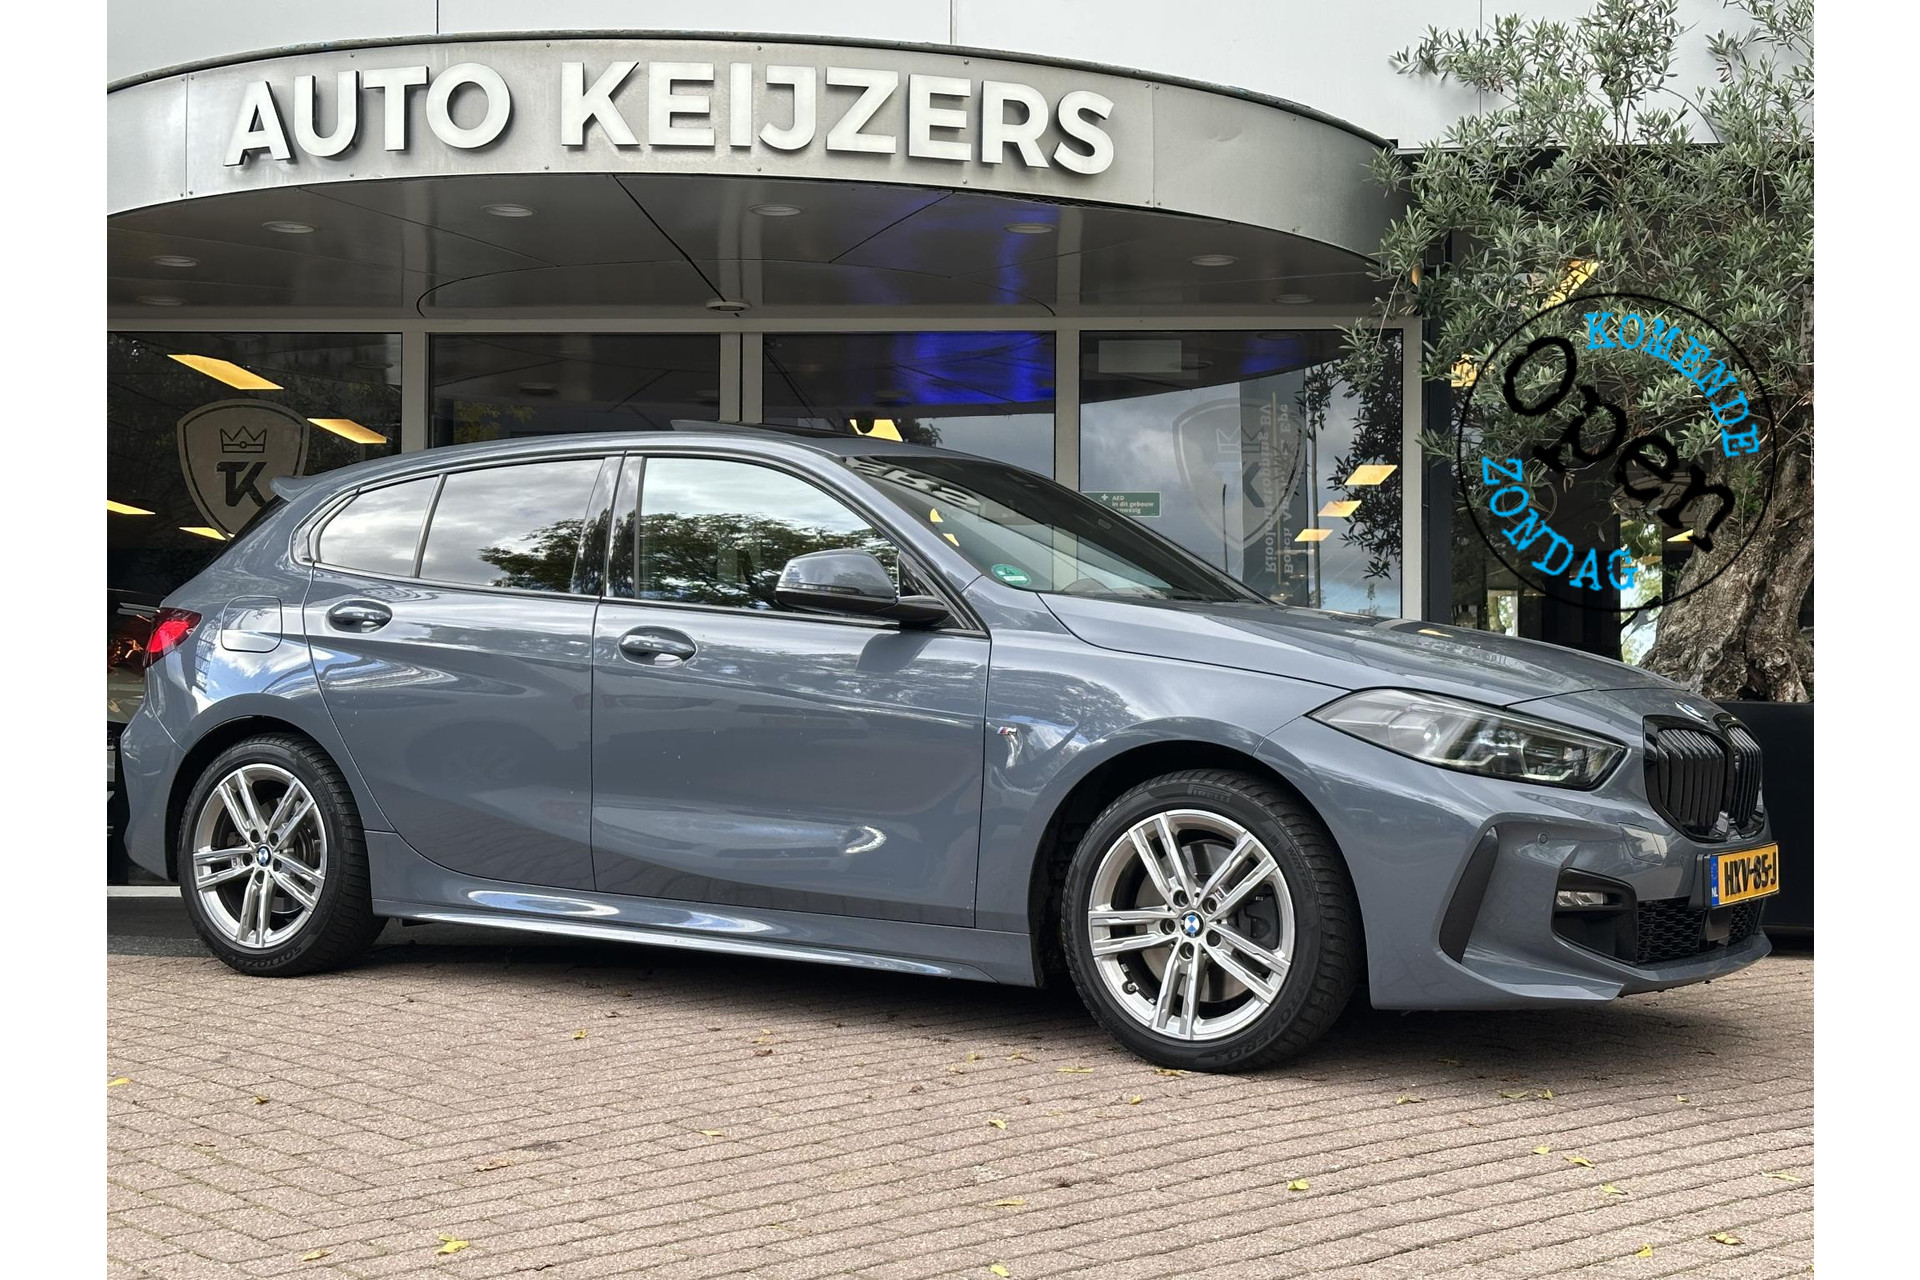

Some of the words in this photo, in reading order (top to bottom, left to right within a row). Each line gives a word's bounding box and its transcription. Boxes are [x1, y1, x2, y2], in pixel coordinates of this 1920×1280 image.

[225, 62, 511, 167] AUTO
[561, 61, 1115, 175] KEIJZERS
[217, 461, 267, 508] TK
[1711, 887, 1718, 897] NL
[1724, 852, 1776, 897] HXV-85-J
